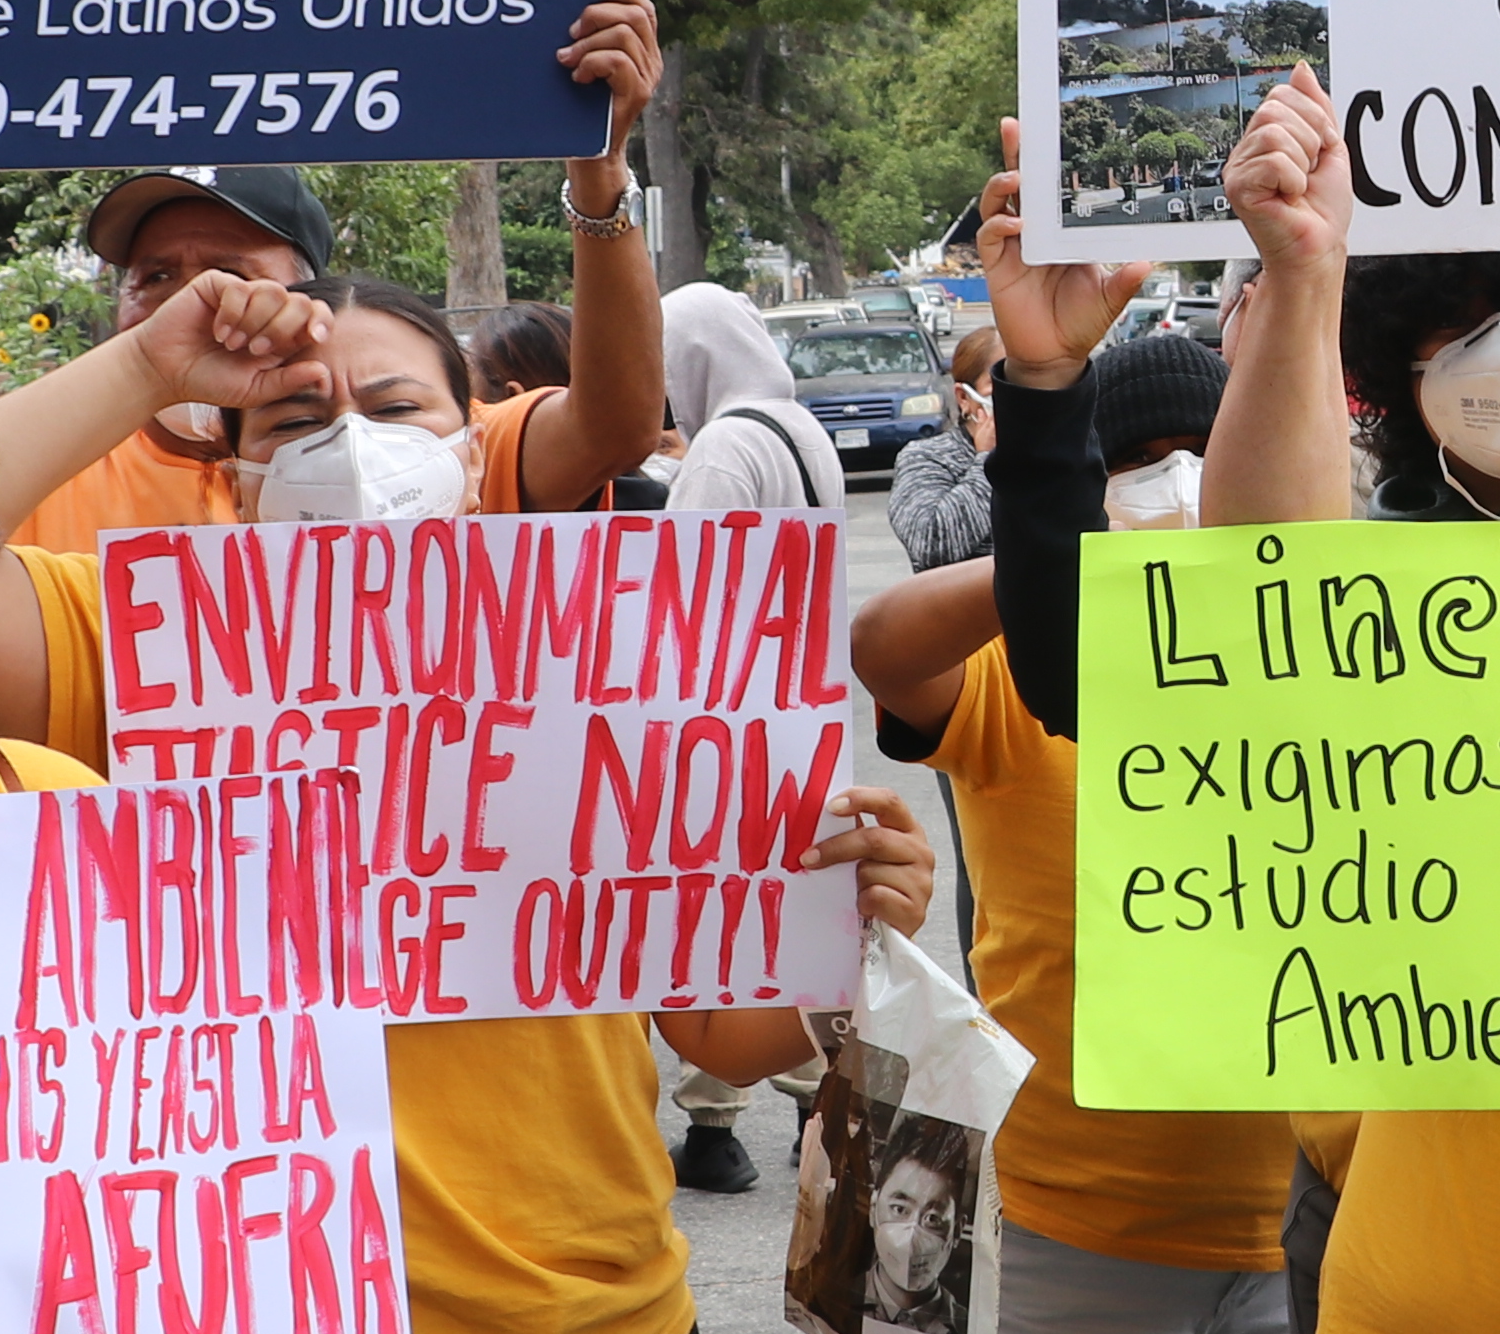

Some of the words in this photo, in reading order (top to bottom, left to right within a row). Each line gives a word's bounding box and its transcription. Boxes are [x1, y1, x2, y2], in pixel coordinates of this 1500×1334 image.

[1176, 77, 1193, 86] pm
[1195, 74, 1220, 83] WED
[390, 486, 423, 509] 9502+
[104, 511, 848, 714] ENVIRONMENTAL
[569, 712, 844, 877] NOW
[15, 767, 384, 1033] AMBIENTE
[1122, 830, 1458, 934] estudio
[258, 1014, 338, 1143] LA
